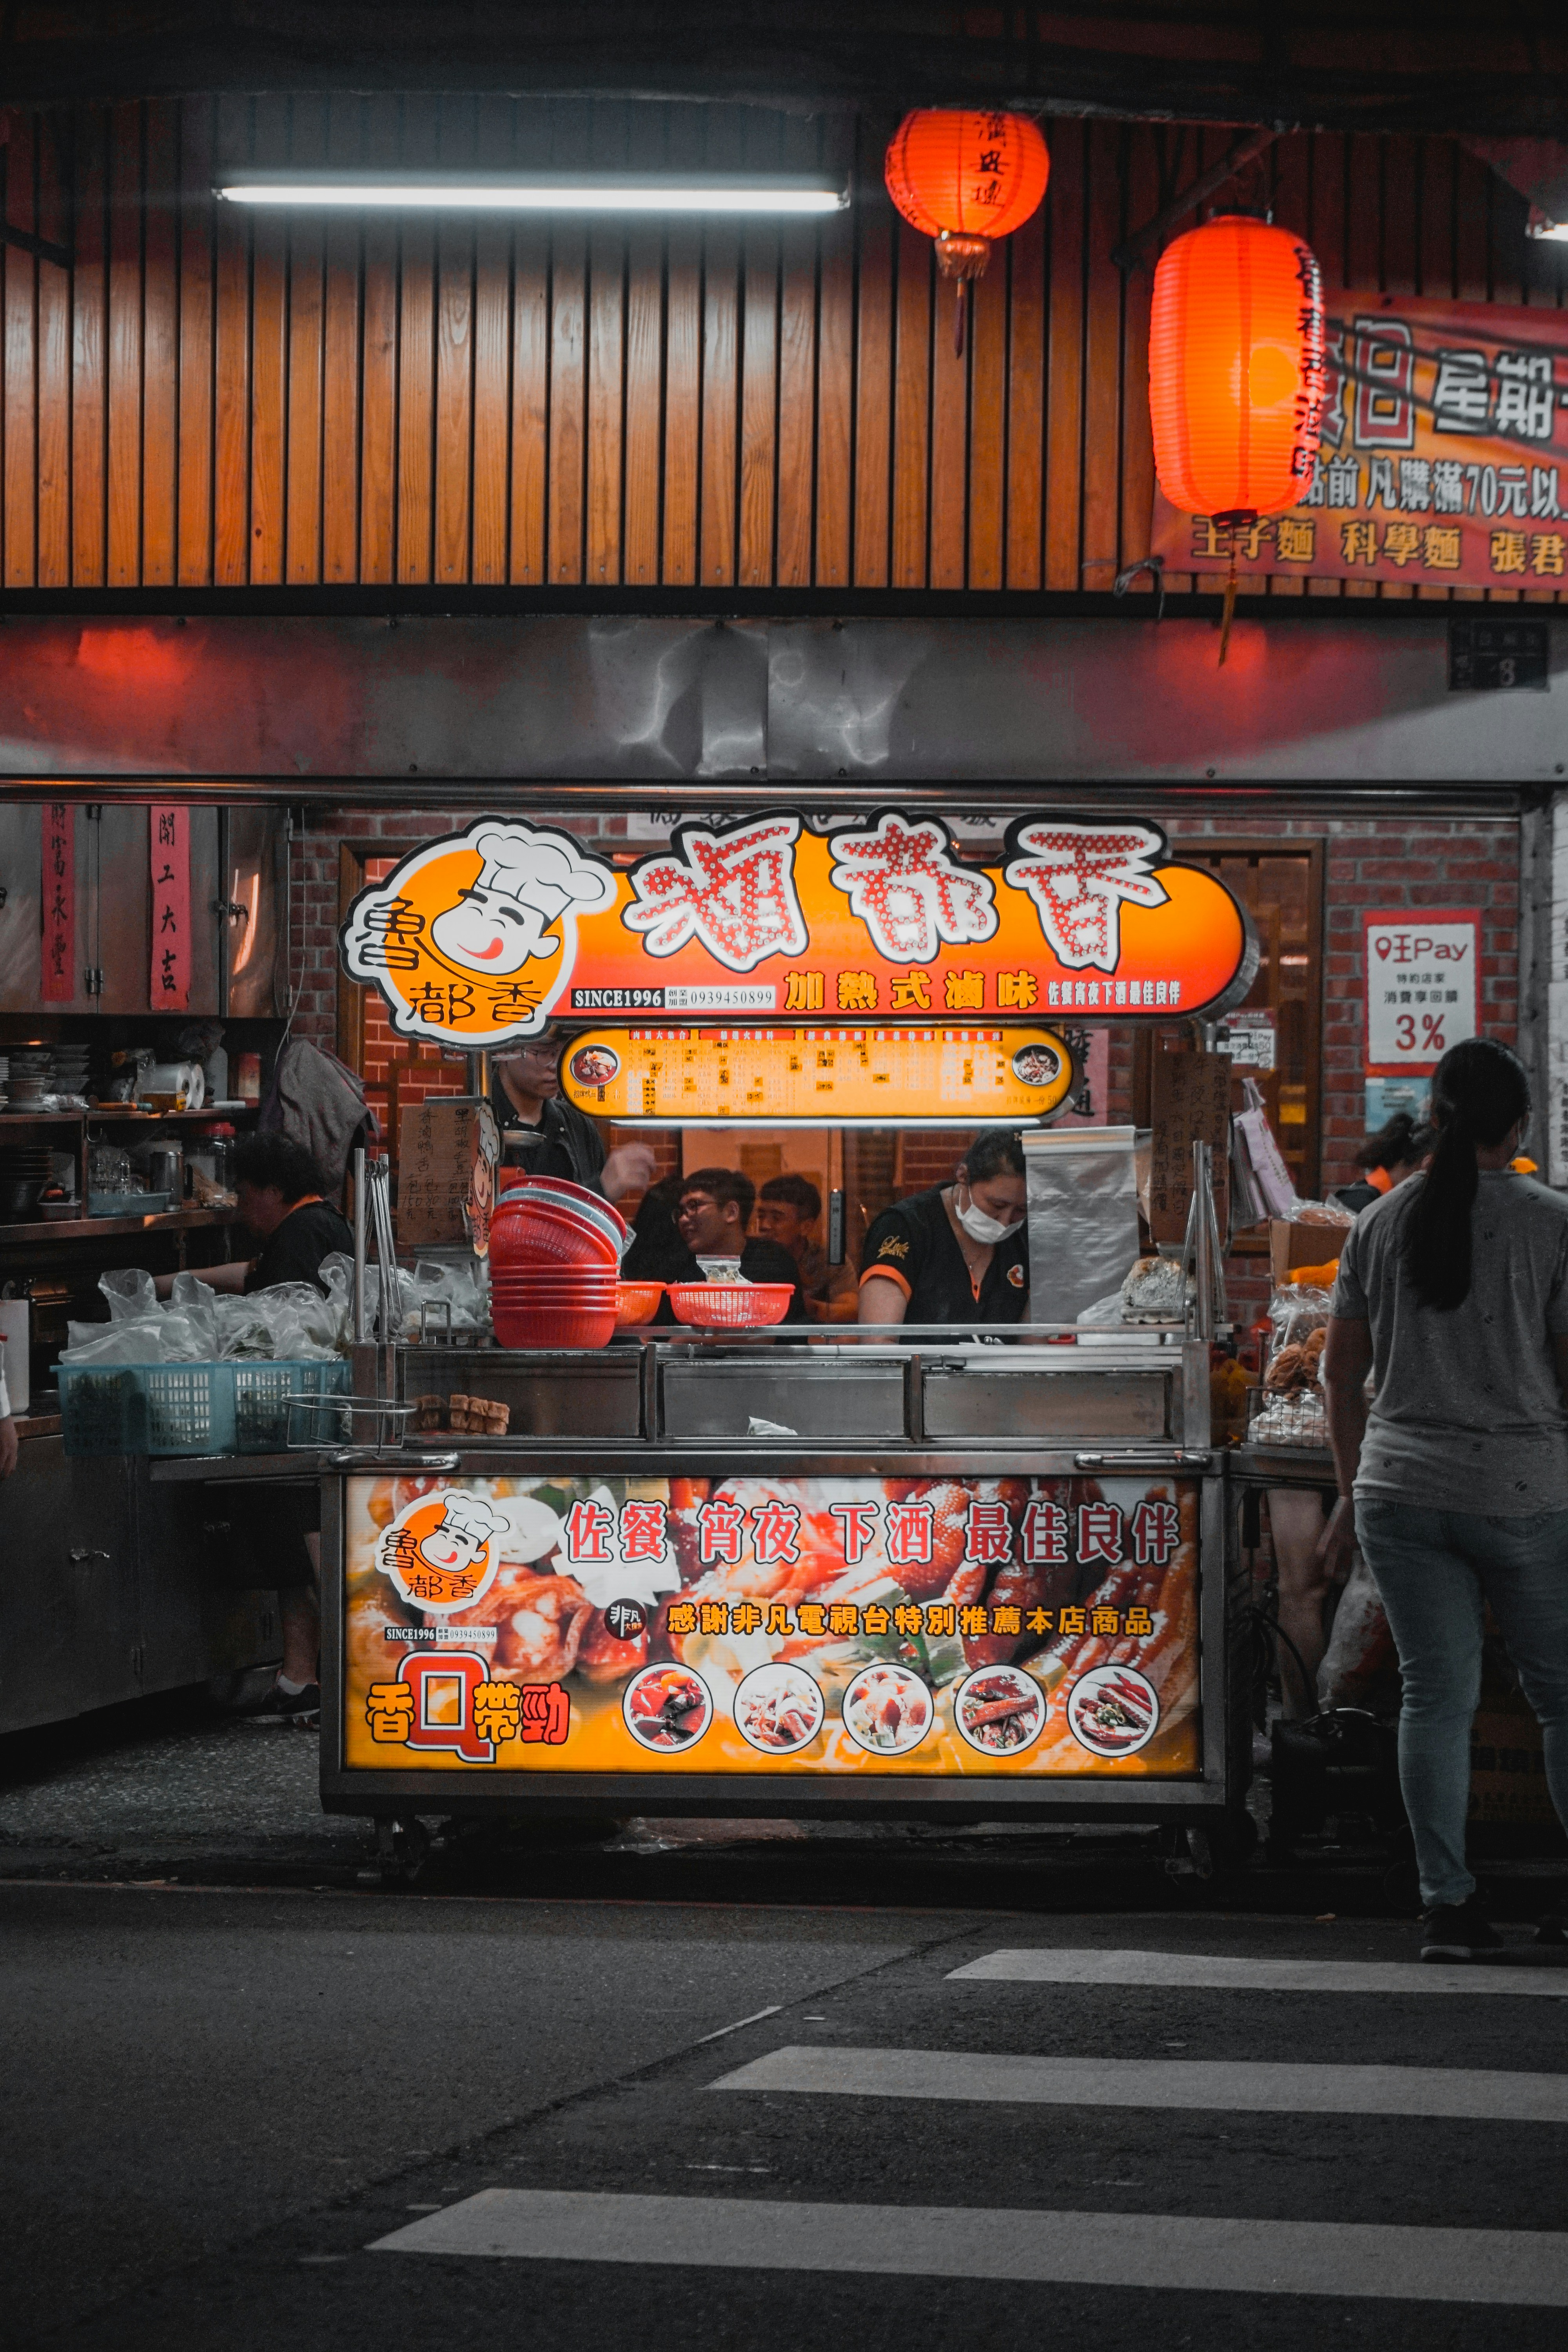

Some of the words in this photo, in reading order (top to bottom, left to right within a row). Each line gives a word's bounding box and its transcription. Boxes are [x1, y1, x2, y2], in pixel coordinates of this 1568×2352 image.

[1433, 350, 1568, 439] 星期
[1366, 457, 1568, 523] 凡購滿70元以
[1192, 516, 1314, 562] 王子麵
[1341, 522, 1461, 570] 科學麵
[1490, 530, 1566, 577] 張君
[158, 812, 176, 992] 開工大吉
[575, 989, 662, 1007] SINCE1996
[691, 991, 772, 1005] 0939450899
[784, 970, 1039, 1011] 加熱式滷味
[1047, 980, 1181, 1006] 佐餐宵夜下酒最佳良伴
[632, 1031, 686, 1040] 肉類大集合
[1395, 1013, 1446, 1051] 3%
[566, 1500, 668, 1563] 佐餐
[697, 1501, 801, 1564] 宵夜
[829, 1501, 935, 1564] 下酒
[964, 1501, 1181, 1564] 最佳良伴
[386, 1628, 435, 1640] SINCE1996
[450, 1630, 495, 1639] 0939450899
[667, 1602, 1154, 1637] 感謝非凡電視台特別推薦本店商品
[365, 1650, 570, 1763] 香Q帶勁
